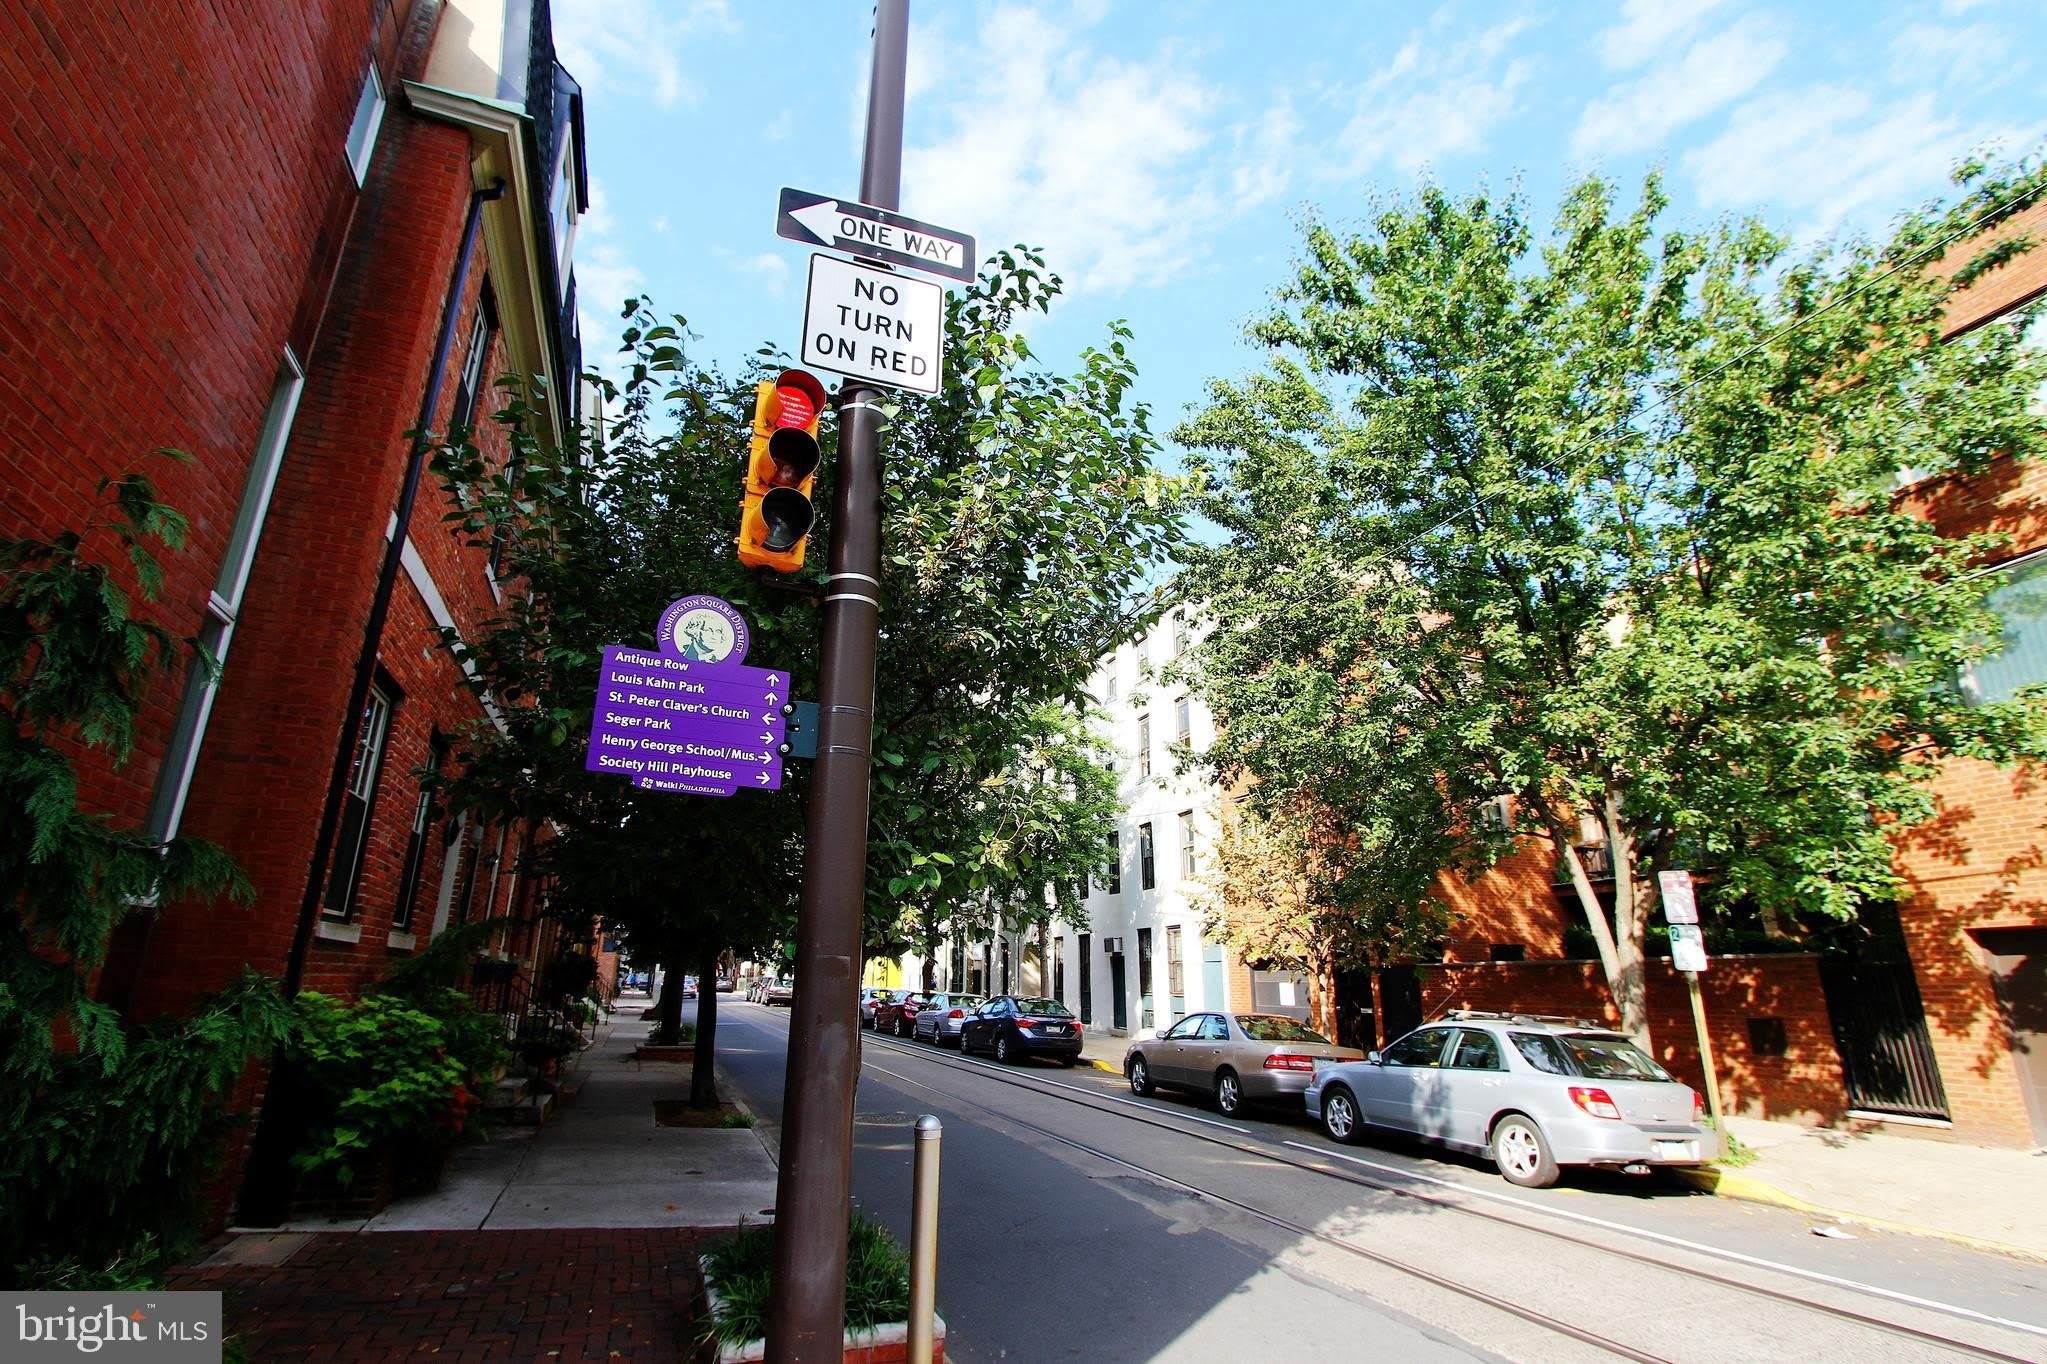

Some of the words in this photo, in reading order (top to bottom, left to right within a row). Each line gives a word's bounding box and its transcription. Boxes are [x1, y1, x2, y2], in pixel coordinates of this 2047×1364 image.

[840, 217, 892, 246] ONE
[904, 232, 954, 261] WAY
[854, 277, 899, 306] NO
[836, 304, 913, 342] TURN
[815, 333, 856, 362] ON
[870, 345, 927, 376] RED
[661, 599, 699, 641] WASHINGTON
[700, 596, 733, 617] SQUARE
[730, 612, 745, 653] DISTRICT
[615, 651, 661, 668] Antique
[664, 660, 689, 671] Row
[611, 672, 643, 685] Louis
[646, 676, 676, 690] Kahn
[679, 681, 705, 694] Park
[608, 691, 625, 703] St.
[628, 694, 660, 708] Peter
[663, 698, 708, 714] Claver's
[711, 705, 750, 720] Church
[605, 712, 641, 727] Seger
[644, 717, 672, 730] Park
[602, 734, 638, 750] Henry
[641, 738, 683, 754] George
[685, 744, 759, 761] School/Mus.
[599, 755, 645, 772] Society
[648, 760, 669, 773] Hill
[671, 764, 732, 779] Playhouse
